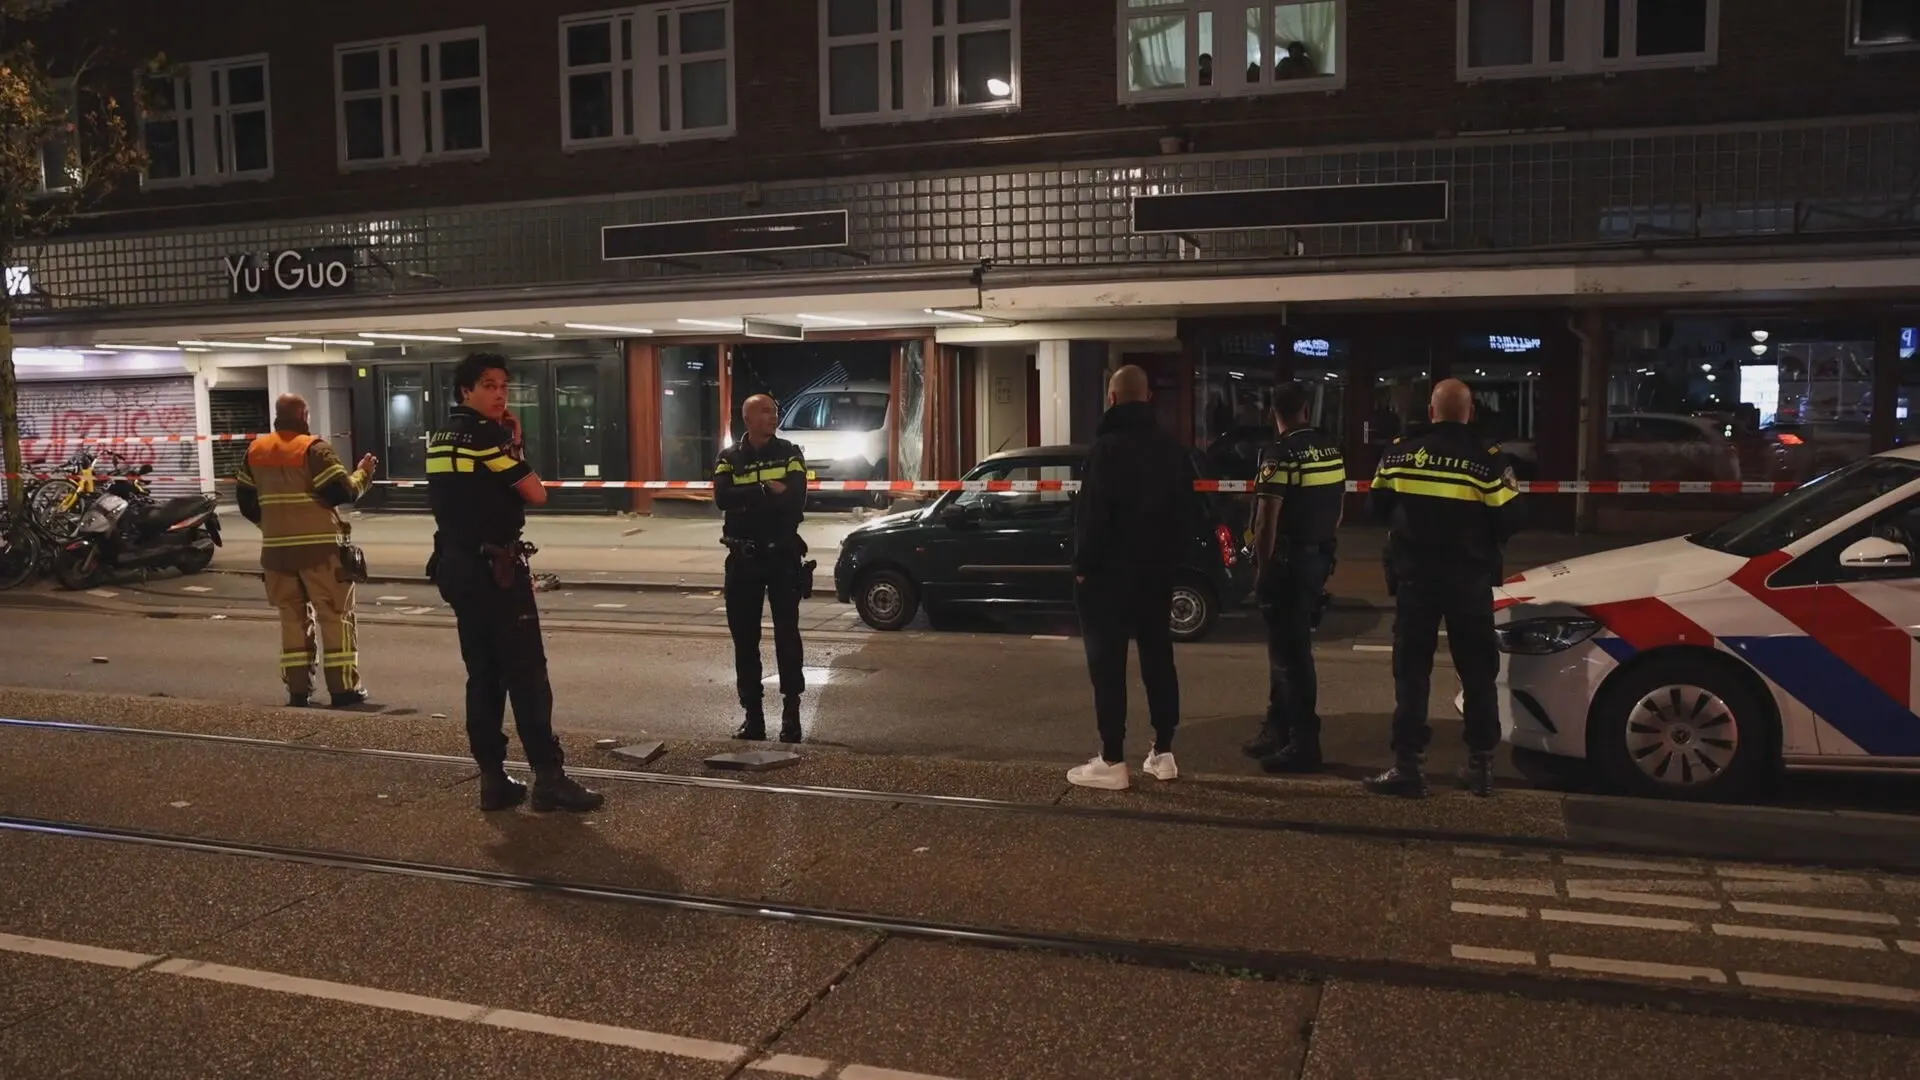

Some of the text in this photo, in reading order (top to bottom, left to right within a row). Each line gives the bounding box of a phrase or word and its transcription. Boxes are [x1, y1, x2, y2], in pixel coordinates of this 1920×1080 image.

[224, 250, 347, 294] Yu Guo
[1405, 452, 1469, 468] POLITIE
